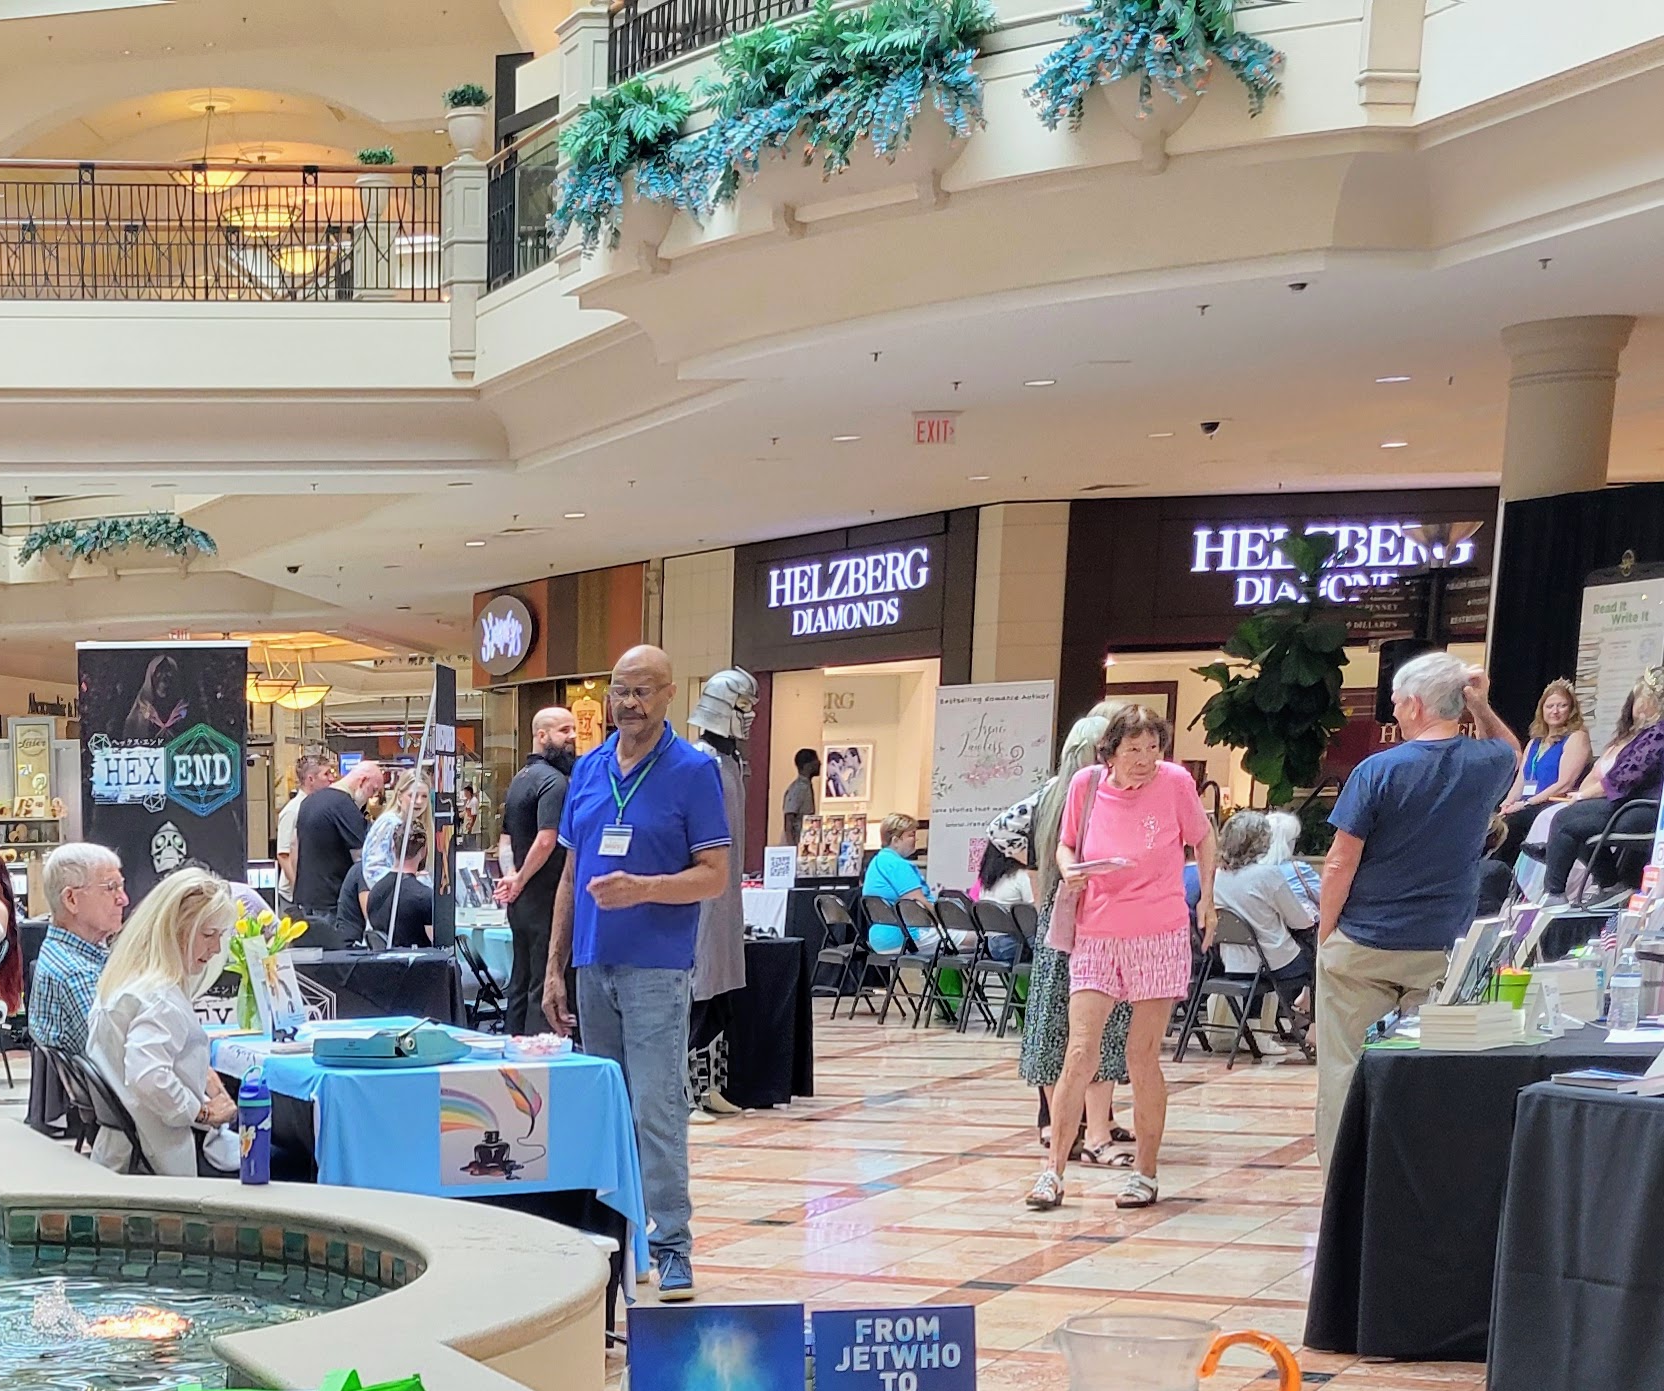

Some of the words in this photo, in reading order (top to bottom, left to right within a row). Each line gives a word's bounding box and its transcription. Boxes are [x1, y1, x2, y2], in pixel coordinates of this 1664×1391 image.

[917, 419, 950, 443] EXIT
[768, 547, 929, 608] HELZBERG
[792, 597, 900, 636] DIAMONDS
[1593, 602, 1618, 614] Read
[1611, 613, 1638, 625] Write
[104, 756, 161, 786] HEX
[173, 753, 232, 787] END
[855, 1316, 940, 1344] FROM
[835, 1343, 961, 1372] JETWHO
